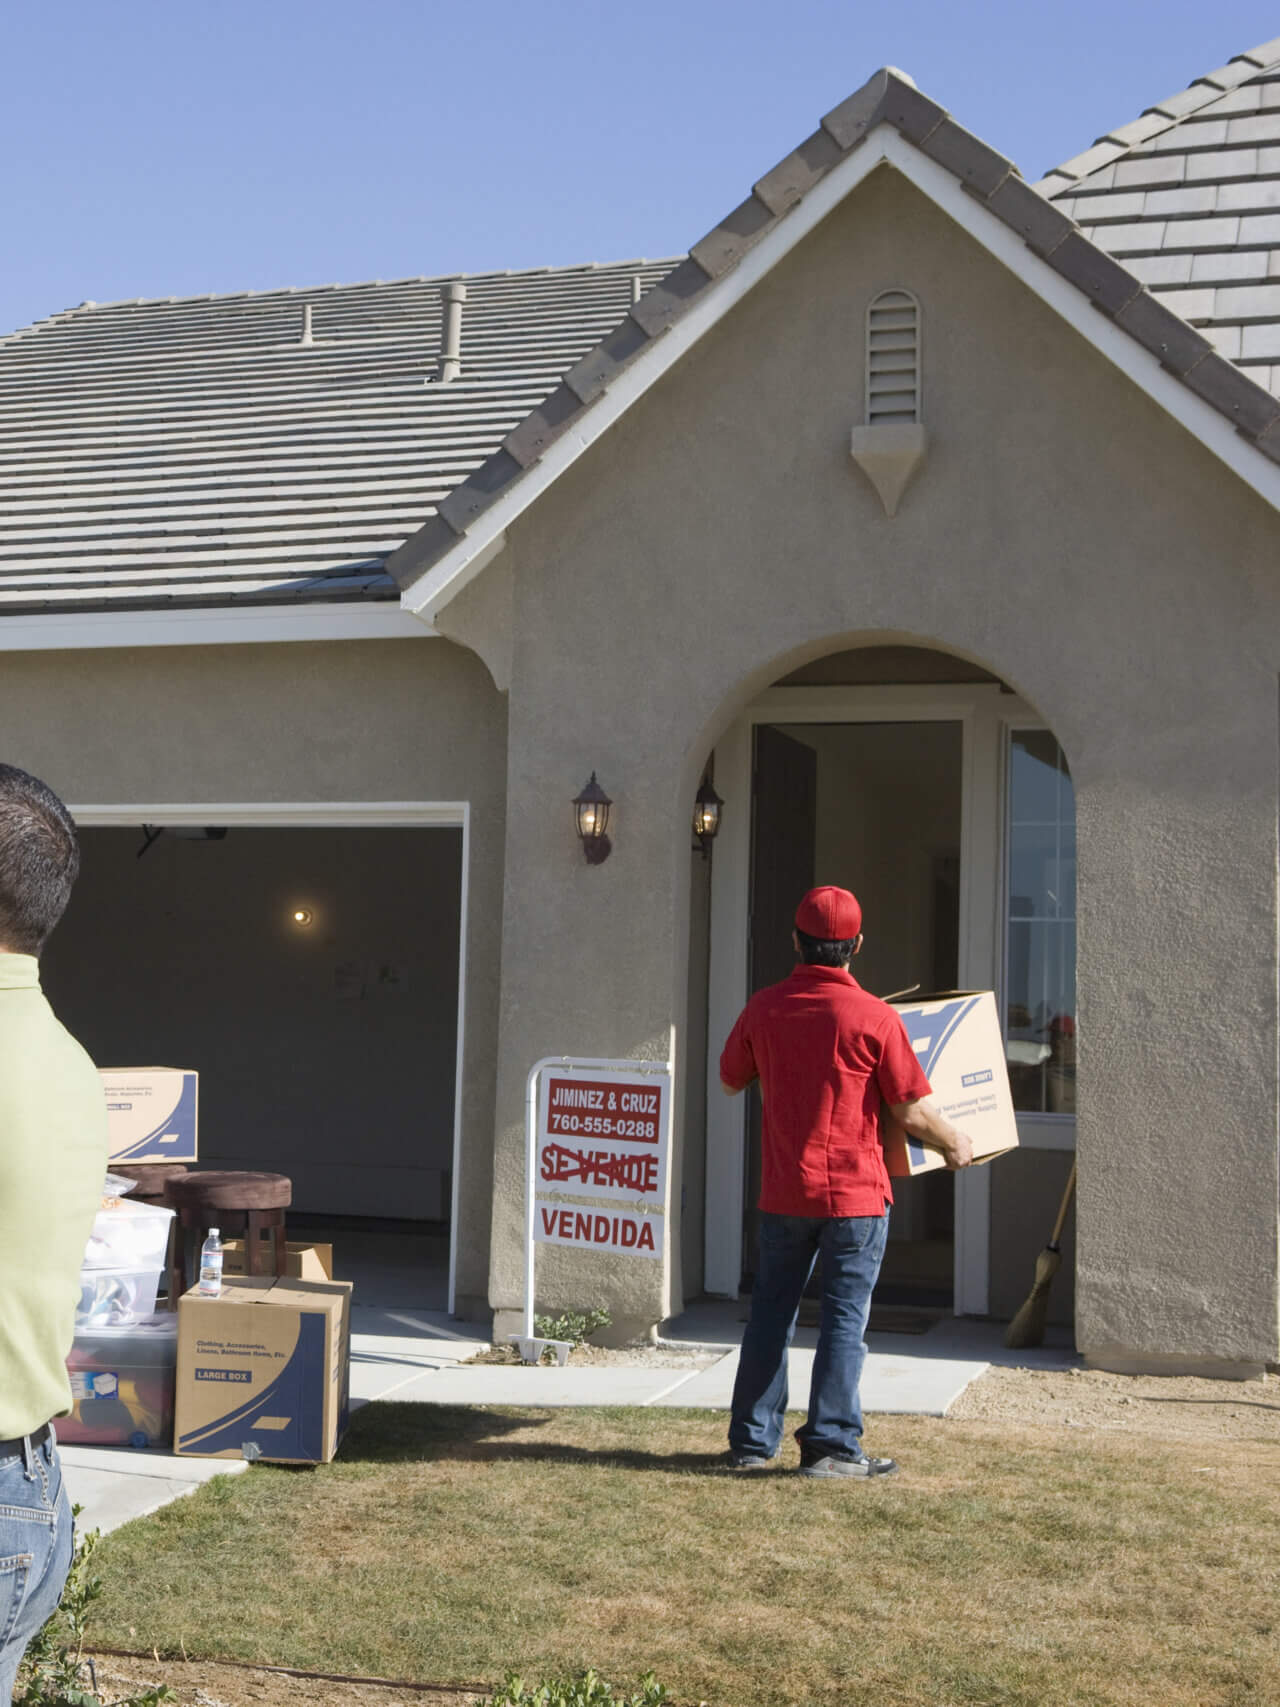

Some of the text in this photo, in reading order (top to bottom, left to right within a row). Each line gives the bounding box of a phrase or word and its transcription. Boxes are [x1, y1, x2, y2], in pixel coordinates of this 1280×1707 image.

[552, 1088, 657, 1114] JIMINEZ & CRUZ
[551, 1114, 655, 1138] 760-555-0288
[541, 1207, 655, 1251] VENDIDA
[198, 1370, 247, 1381] LARGE BOX
